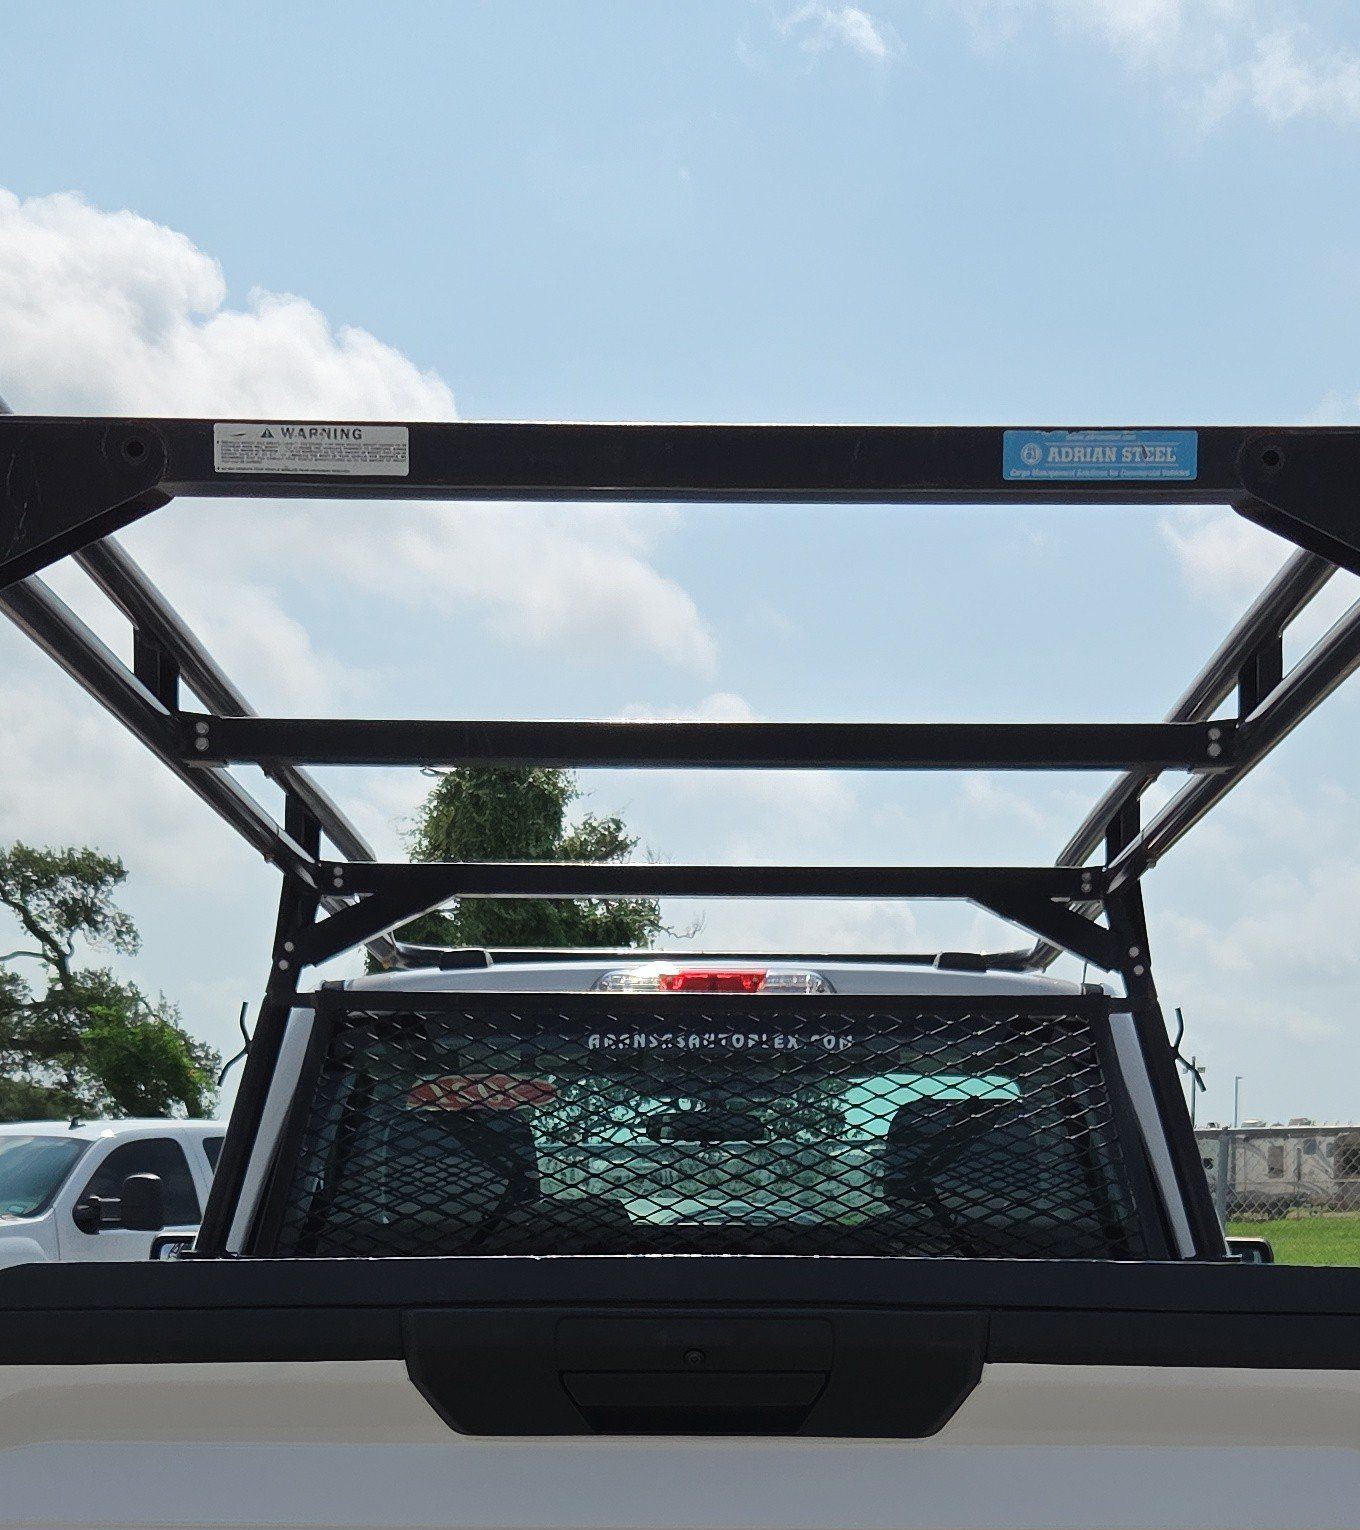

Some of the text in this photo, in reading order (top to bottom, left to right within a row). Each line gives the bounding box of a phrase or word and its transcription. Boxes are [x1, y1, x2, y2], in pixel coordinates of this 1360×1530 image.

[281, 427, 362, 440] WARNING
[1047, 446, 1176, 462] ADRIAN STEEL
